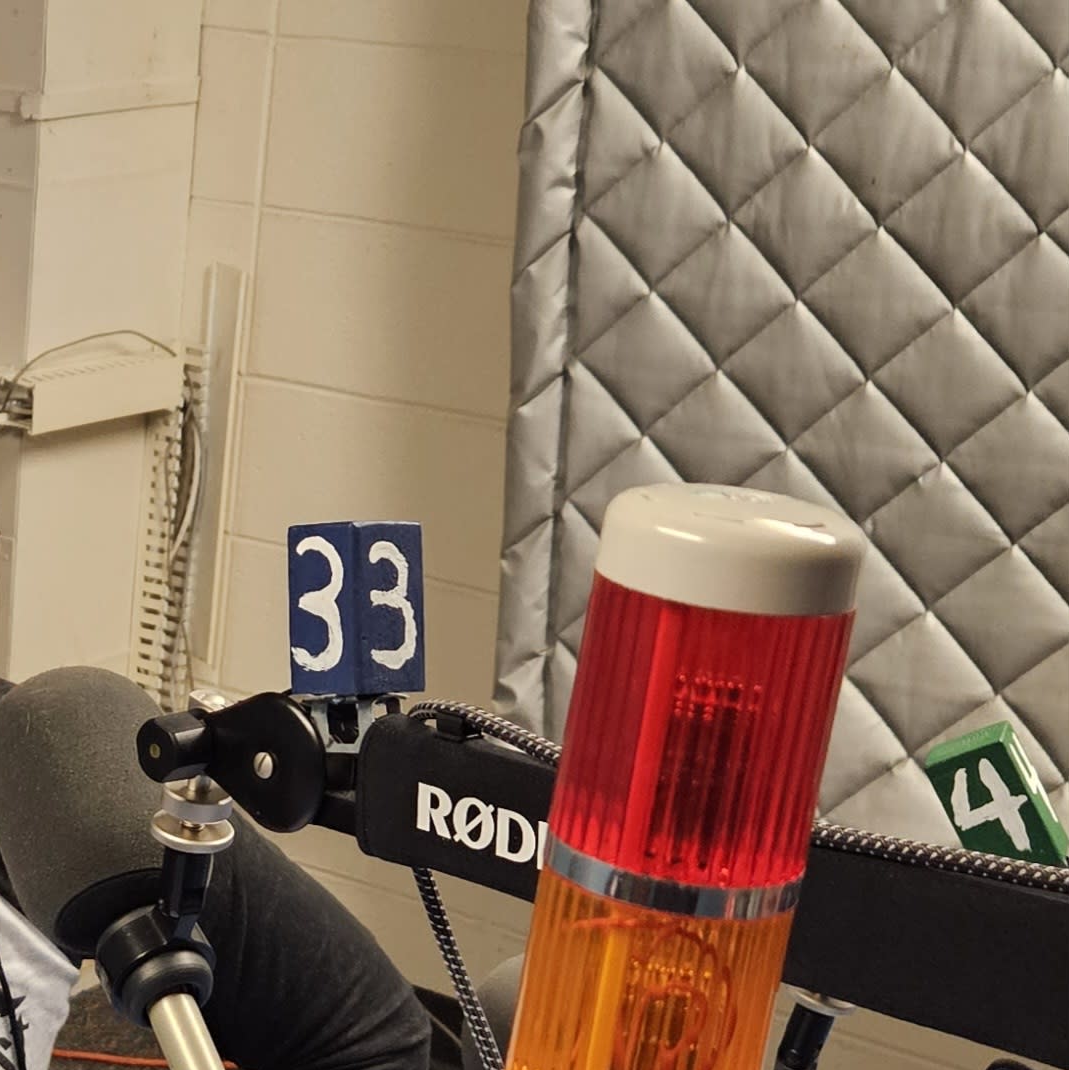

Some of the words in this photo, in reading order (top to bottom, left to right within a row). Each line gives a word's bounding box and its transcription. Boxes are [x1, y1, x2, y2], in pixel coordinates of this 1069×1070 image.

[291, 535, 344, 671] 3
[369, 540, 418, 670] 3
[950, 757, 1032, 852] 4
